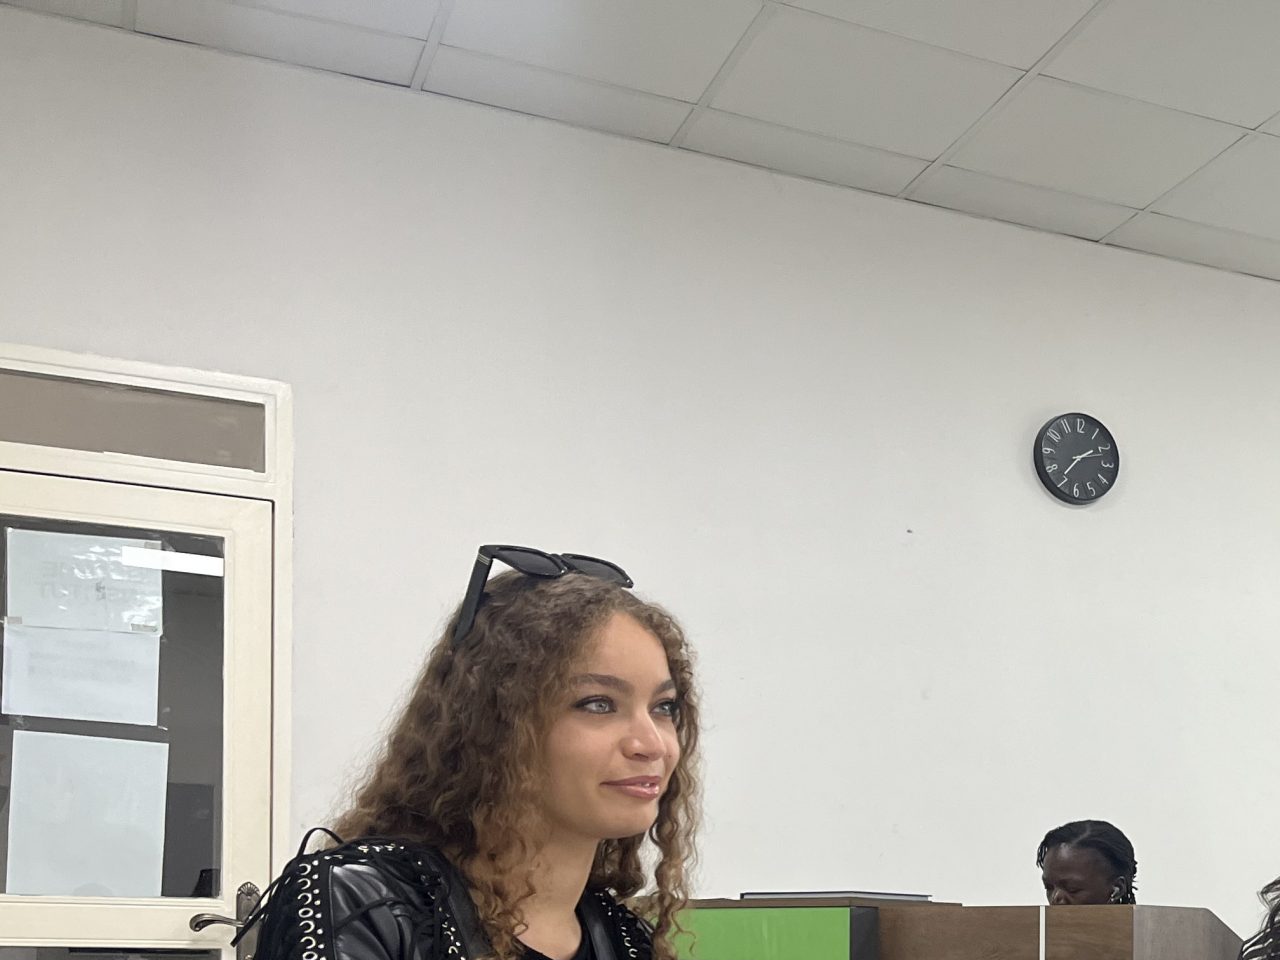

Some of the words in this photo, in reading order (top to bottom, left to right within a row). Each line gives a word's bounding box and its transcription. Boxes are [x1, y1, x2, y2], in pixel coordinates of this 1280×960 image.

[1060, 418, 1072, 434] 11
[1076, 418, 1086, 434] 12
[1046, 428, 1061, 442] 10
[1091, 428, 1099, 440] 1
[1098, 443, 1111, 453] 2
[1046, 463, 1058, 473] 8
[1101, 460, 1114, 469] 3
[1057, 475, 1068, 488] 7
[1097, 473, 1109, 485] 4
[1073, 482, 1080, 498] 6
[1086, 481, 1096, 497] 5
